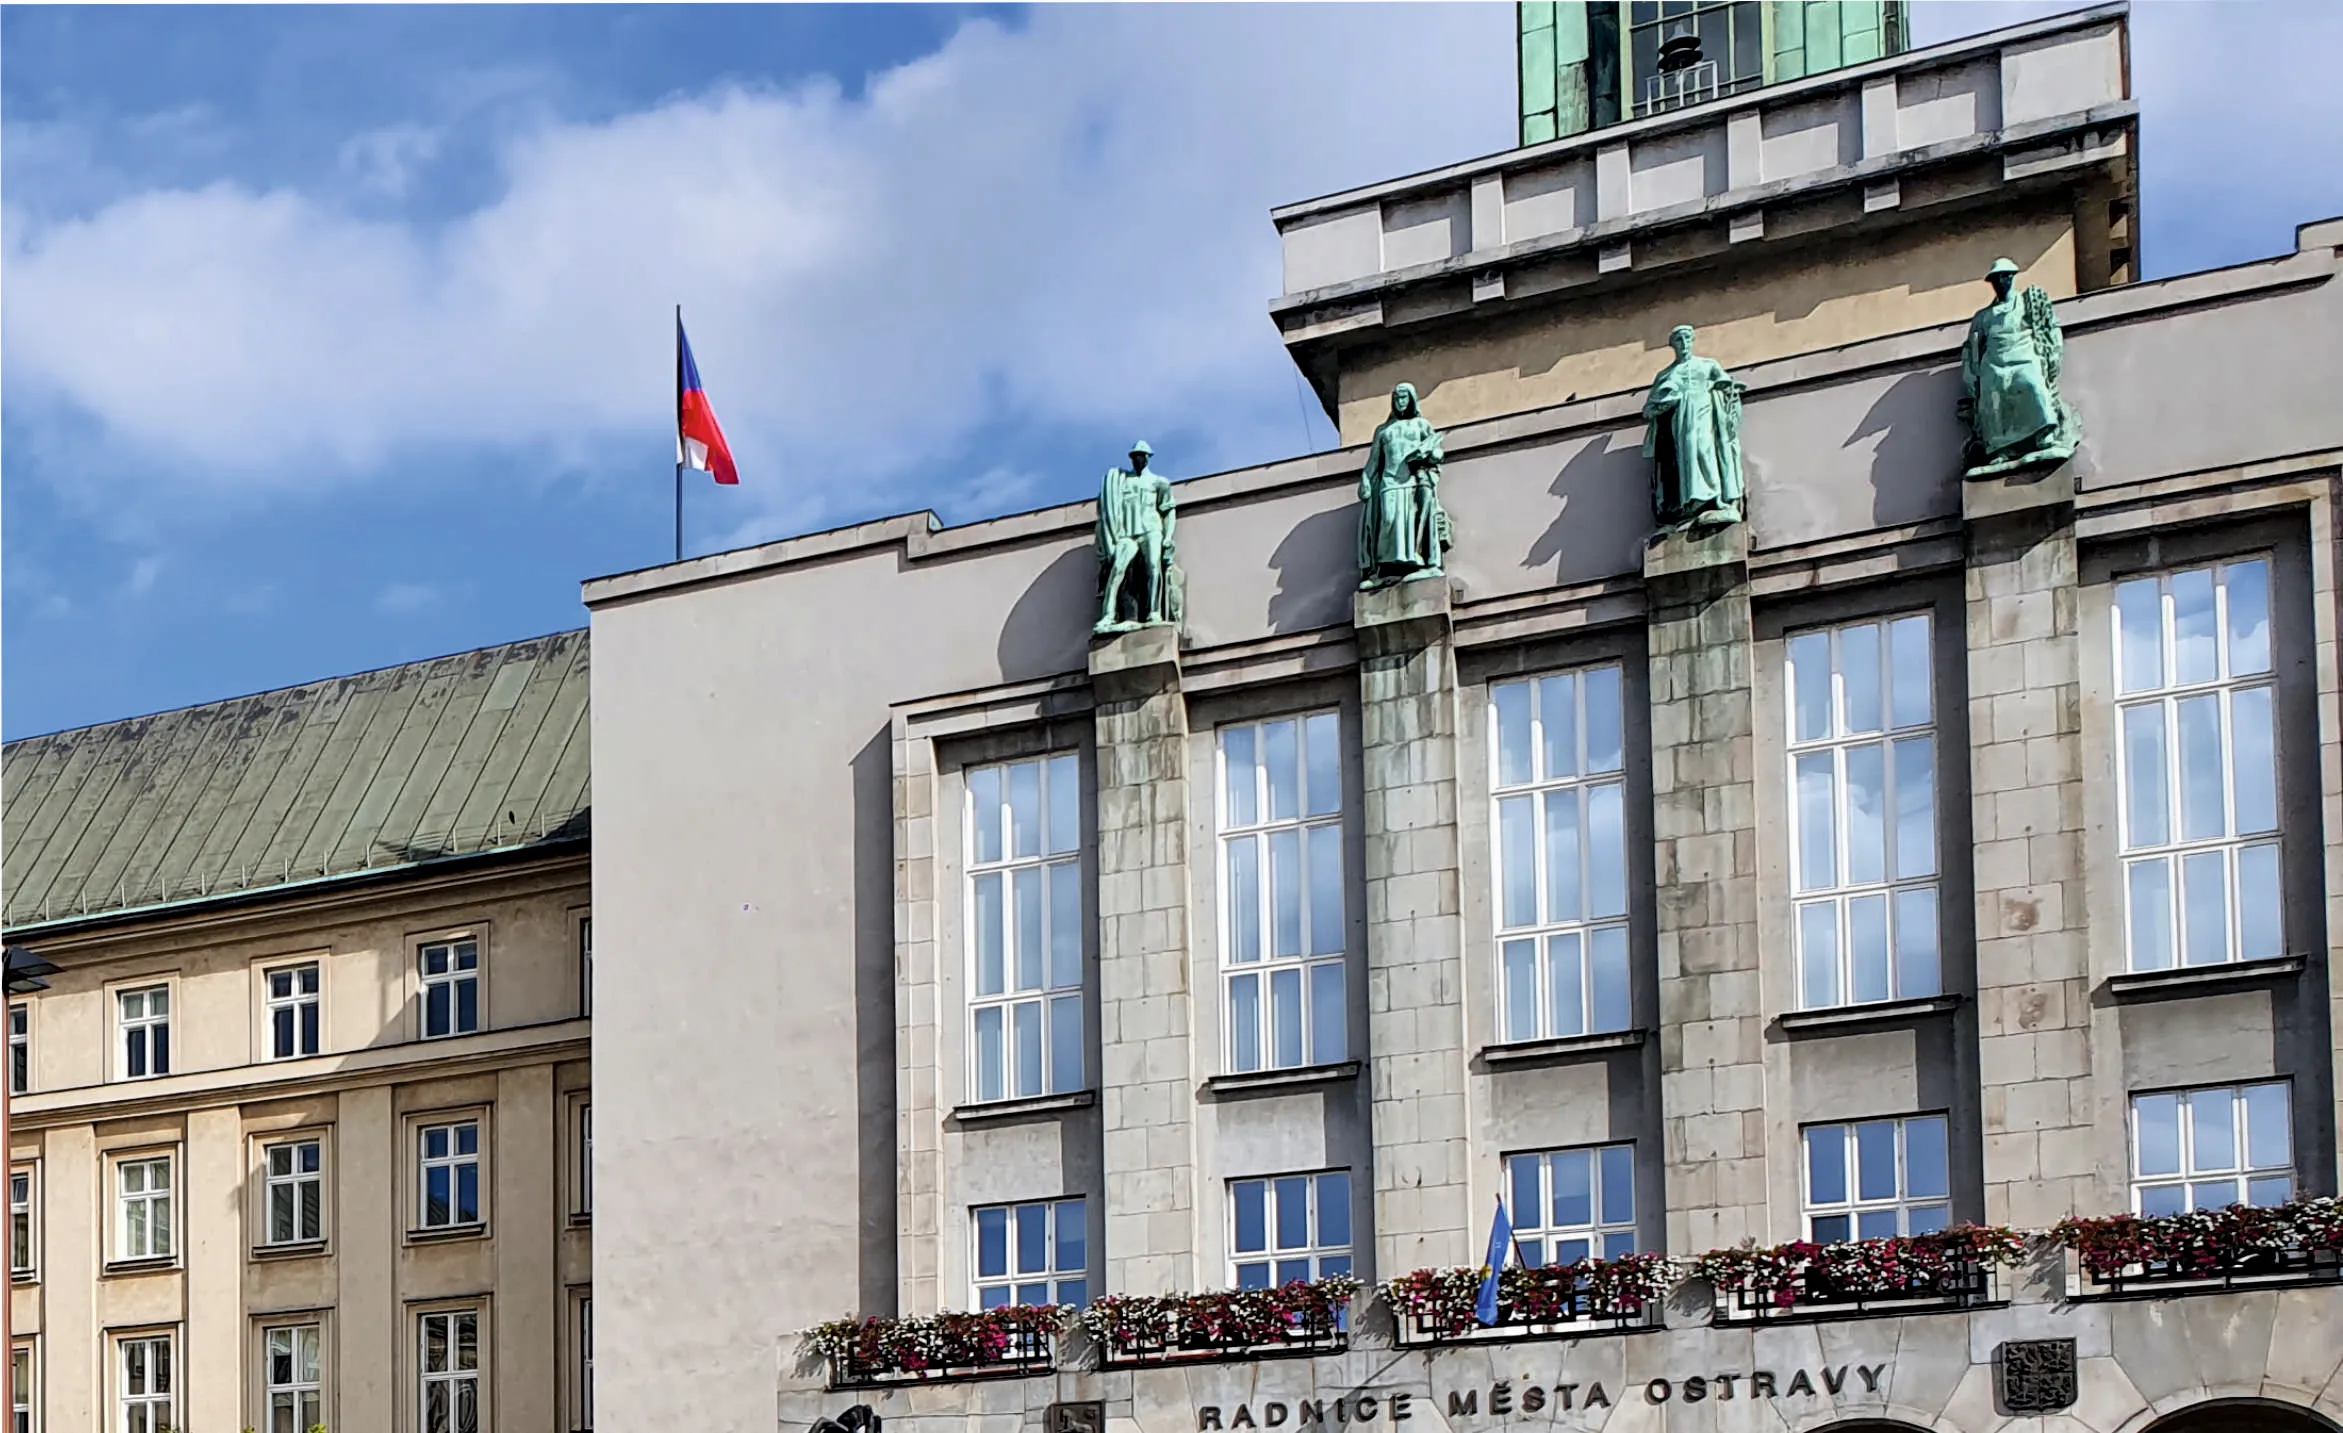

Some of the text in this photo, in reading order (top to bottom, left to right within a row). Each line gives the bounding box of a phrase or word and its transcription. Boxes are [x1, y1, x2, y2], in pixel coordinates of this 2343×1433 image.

[1199, 1363, 1887, 1432] RADNICE MĚSTA OSTRAVY
